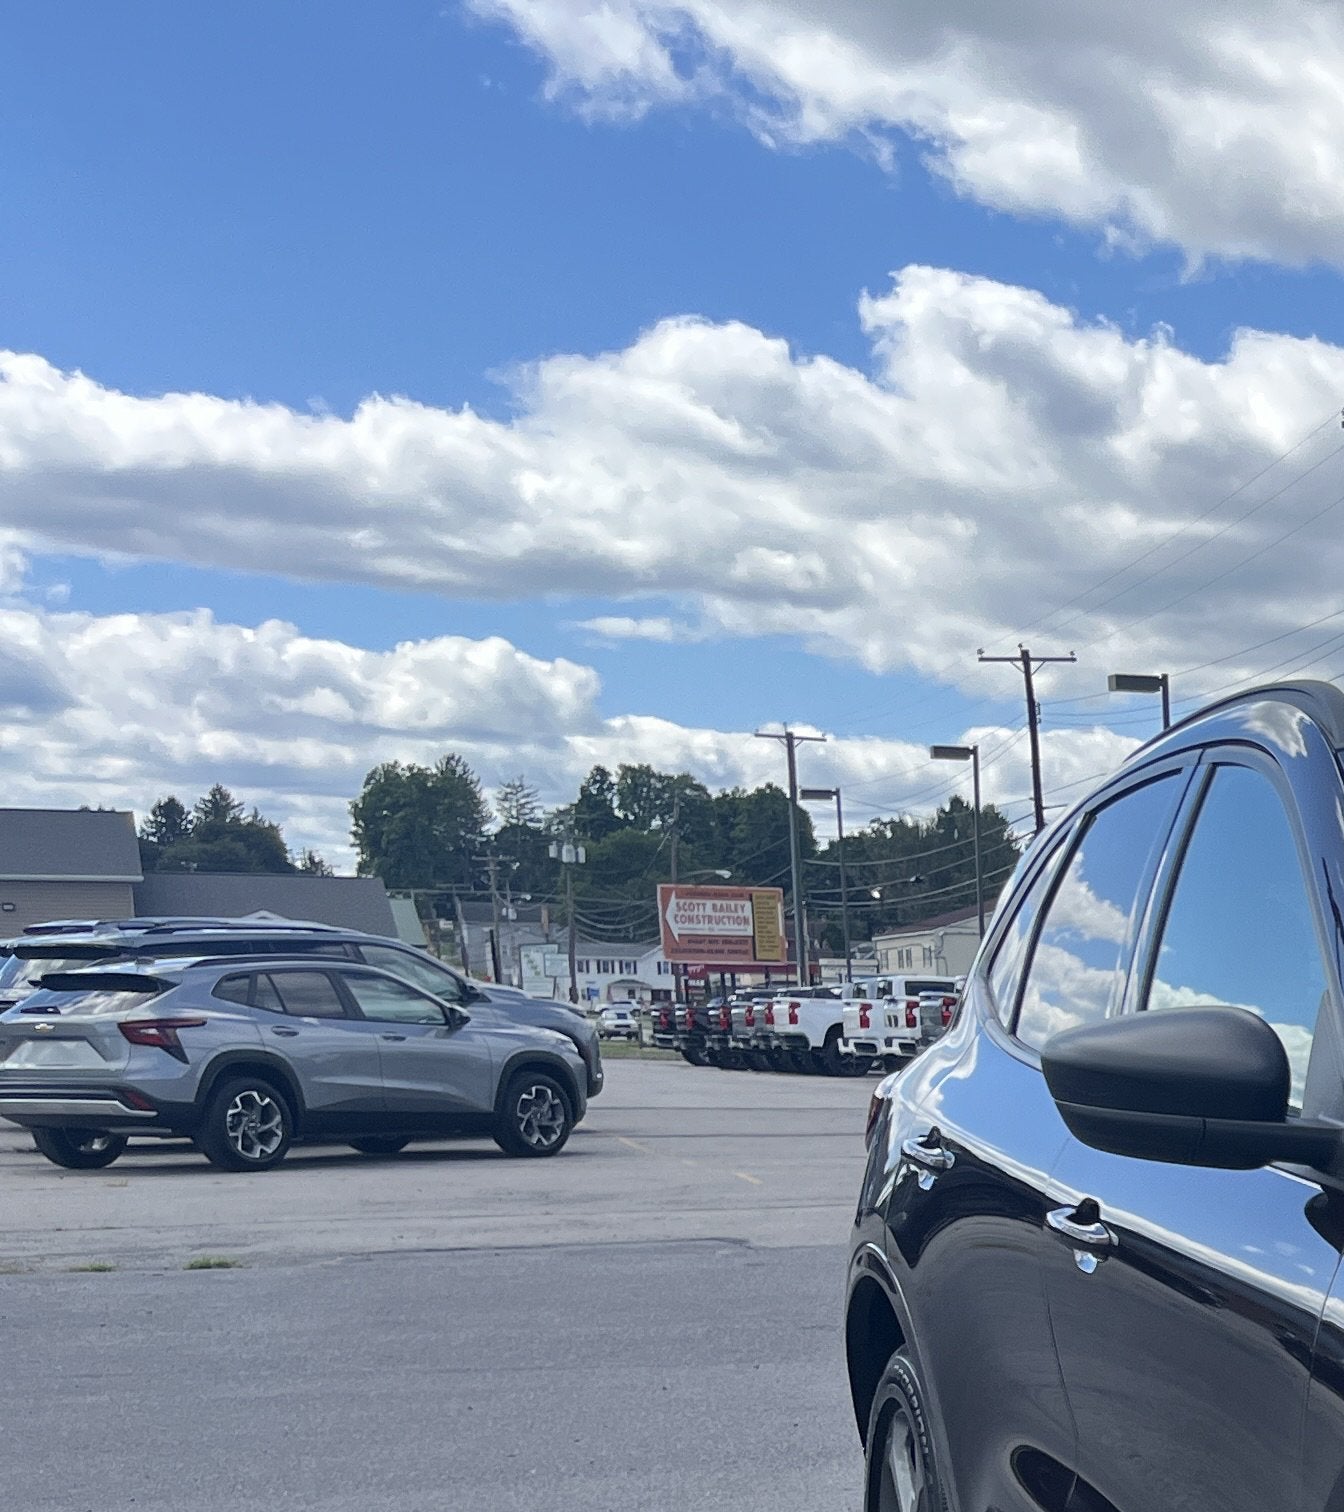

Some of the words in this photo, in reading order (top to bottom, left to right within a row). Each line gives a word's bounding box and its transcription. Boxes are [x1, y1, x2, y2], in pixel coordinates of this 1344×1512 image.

[676, 901, 707, 913] SCOTT
[712, 903, 746, 914] BAILEY
[674, 914, 750, 926] CONSTRUCTION
